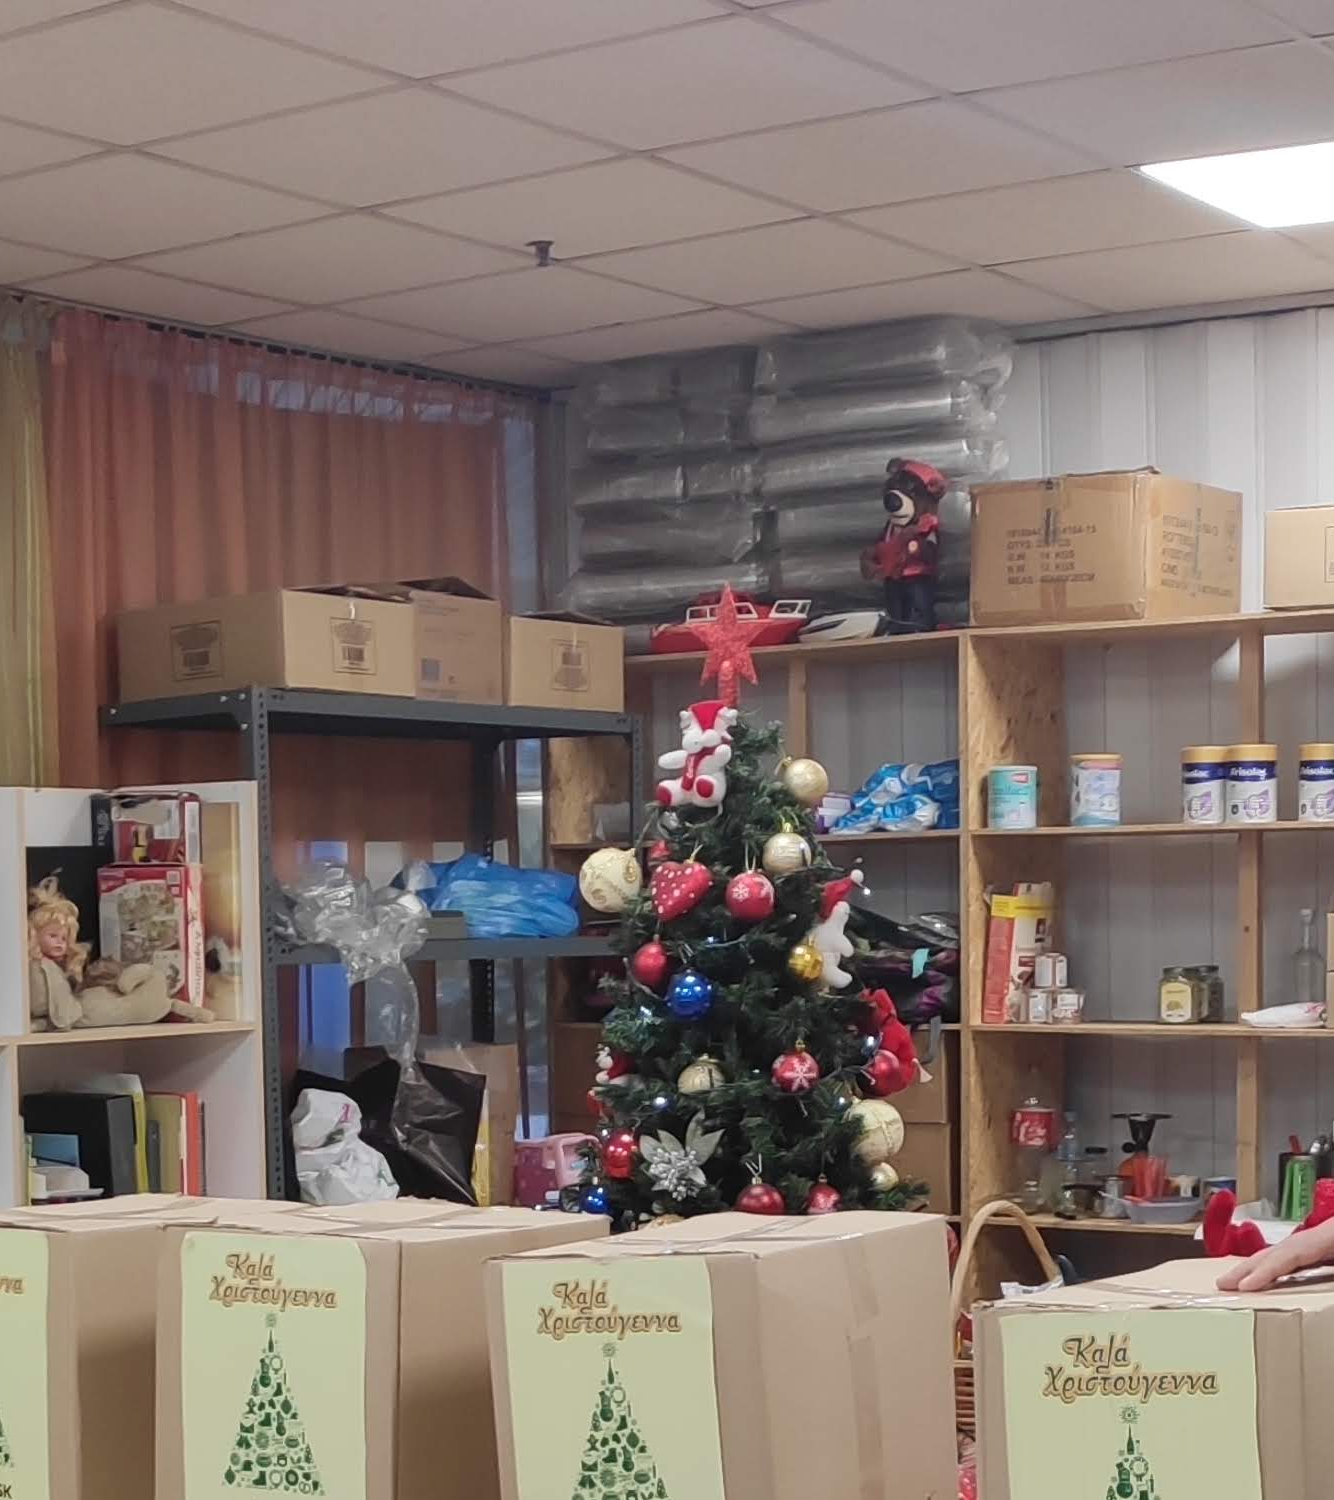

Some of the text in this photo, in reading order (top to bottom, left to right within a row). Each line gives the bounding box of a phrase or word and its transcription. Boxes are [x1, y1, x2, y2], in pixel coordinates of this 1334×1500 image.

[226, 1253, 274, 1284] Καλά
[553, 1279, 609, 1315] Καλά
[1063, 1333, 1131, 1374] Καλά
